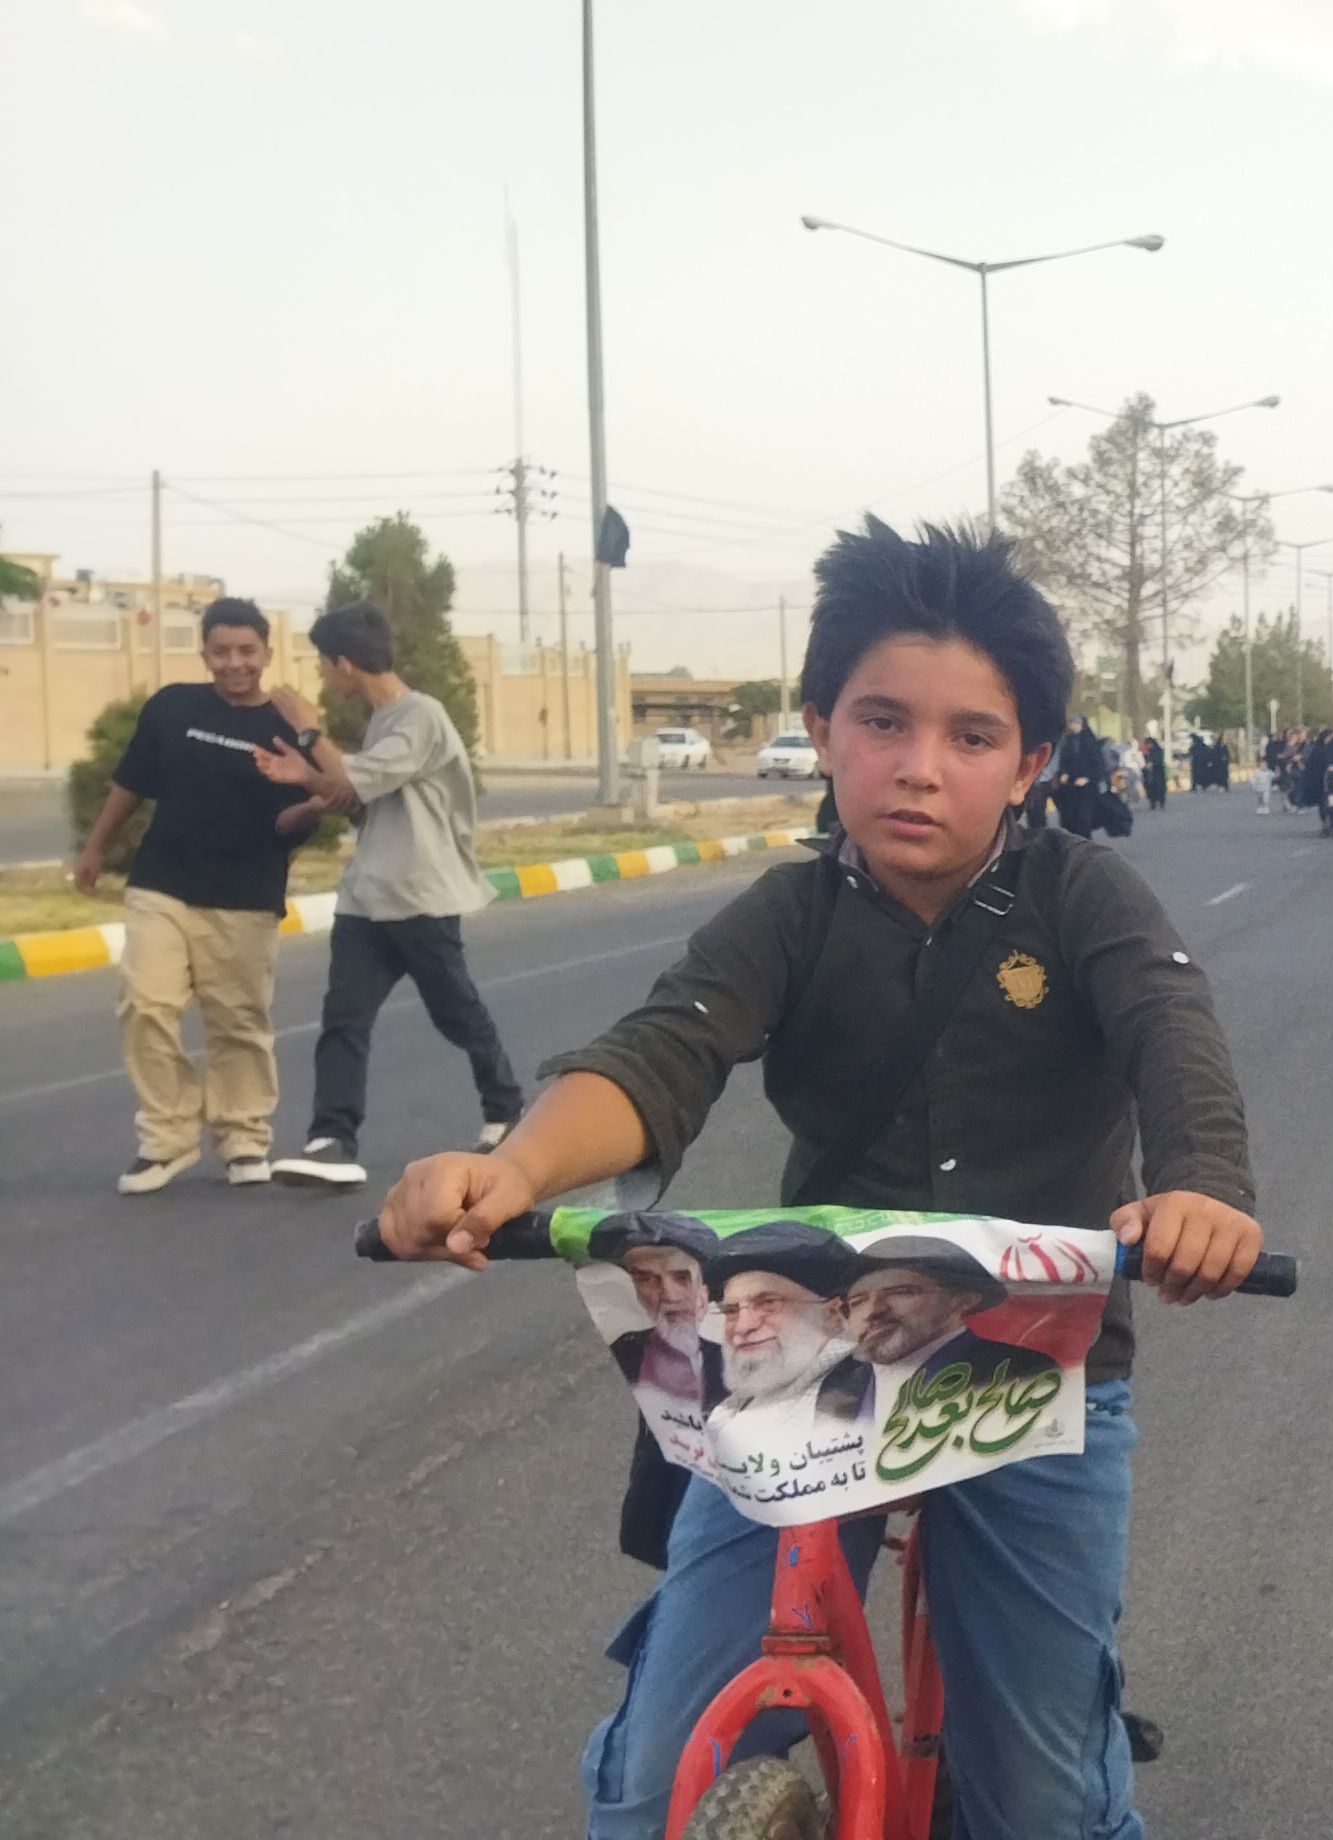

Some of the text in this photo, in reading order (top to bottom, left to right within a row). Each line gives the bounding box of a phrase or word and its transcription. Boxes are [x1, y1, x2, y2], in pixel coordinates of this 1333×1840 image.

[789, 1432, 865, 1470] پشتیبان
[830, 1471, 848, 1491] به
[851, 1460, 867, 1482] تا
[754, 1478, 826, 1503] مملکت
